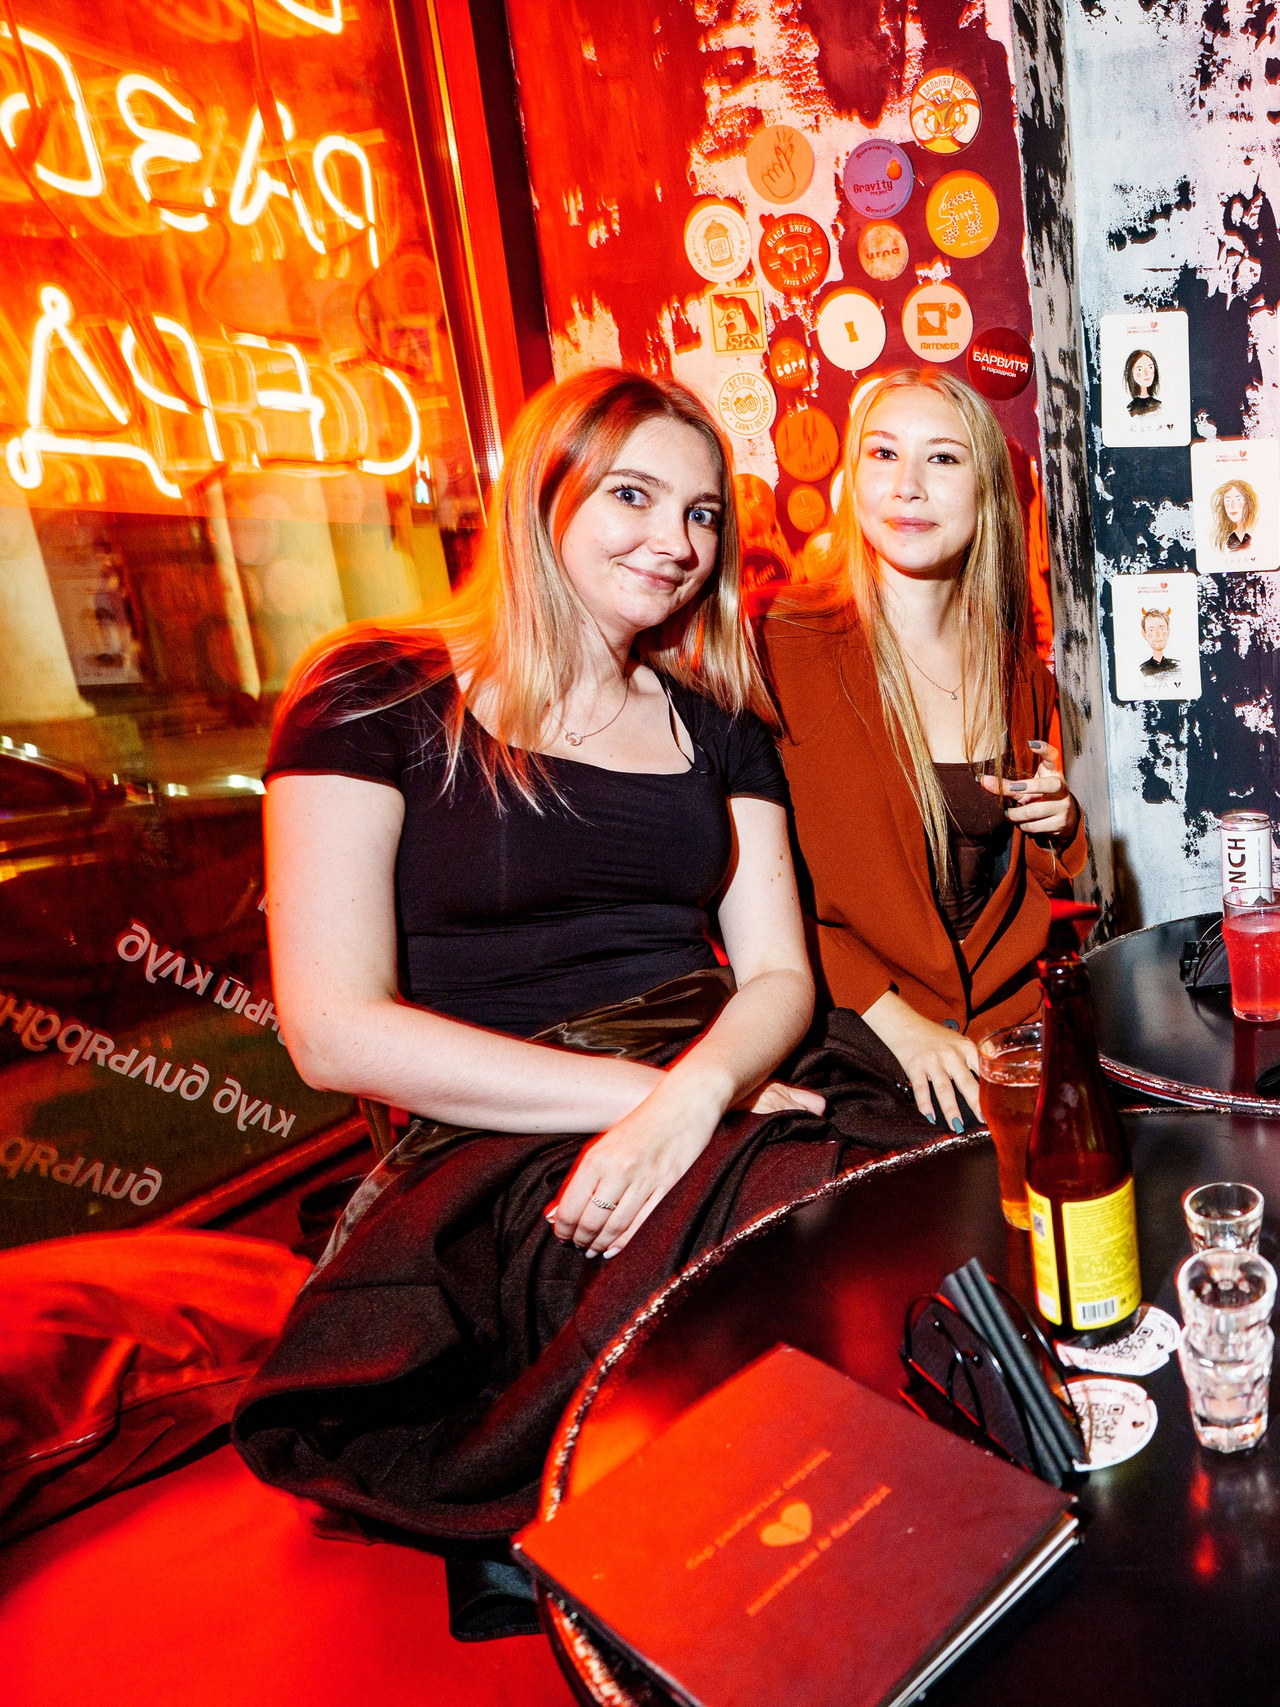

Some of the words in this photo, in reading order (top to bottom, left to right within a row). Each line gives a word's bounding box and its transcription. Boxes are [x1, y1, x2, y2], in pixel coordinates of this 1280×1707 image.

[922, 77, 951, 97] ДАЛЬНЯЯ
[954, 80, 971, 97] ДАЧА
[853, 180, 893, 194] Gravity
[767, 228, 786, 248] BLACK
[790, 225, 812, 234] SHEEP
[710, 240, 727, 251] CRAFT
[712, 247, 729, 258] EVENT
[802, 269, 818, 284] STOUT
[921, 342, 959, 350] ARTENDER
[776, 358, 807, 377] БОРЯ
[973, 352, 1029, 373] БАРВИТЯ
[726, 376, 757, 393] СВЕТЛЫХ
[722, 397, 731, 412] ДВА
[735, 395, 769, 431] САНКТ-ПЕТЕРБУРГ
